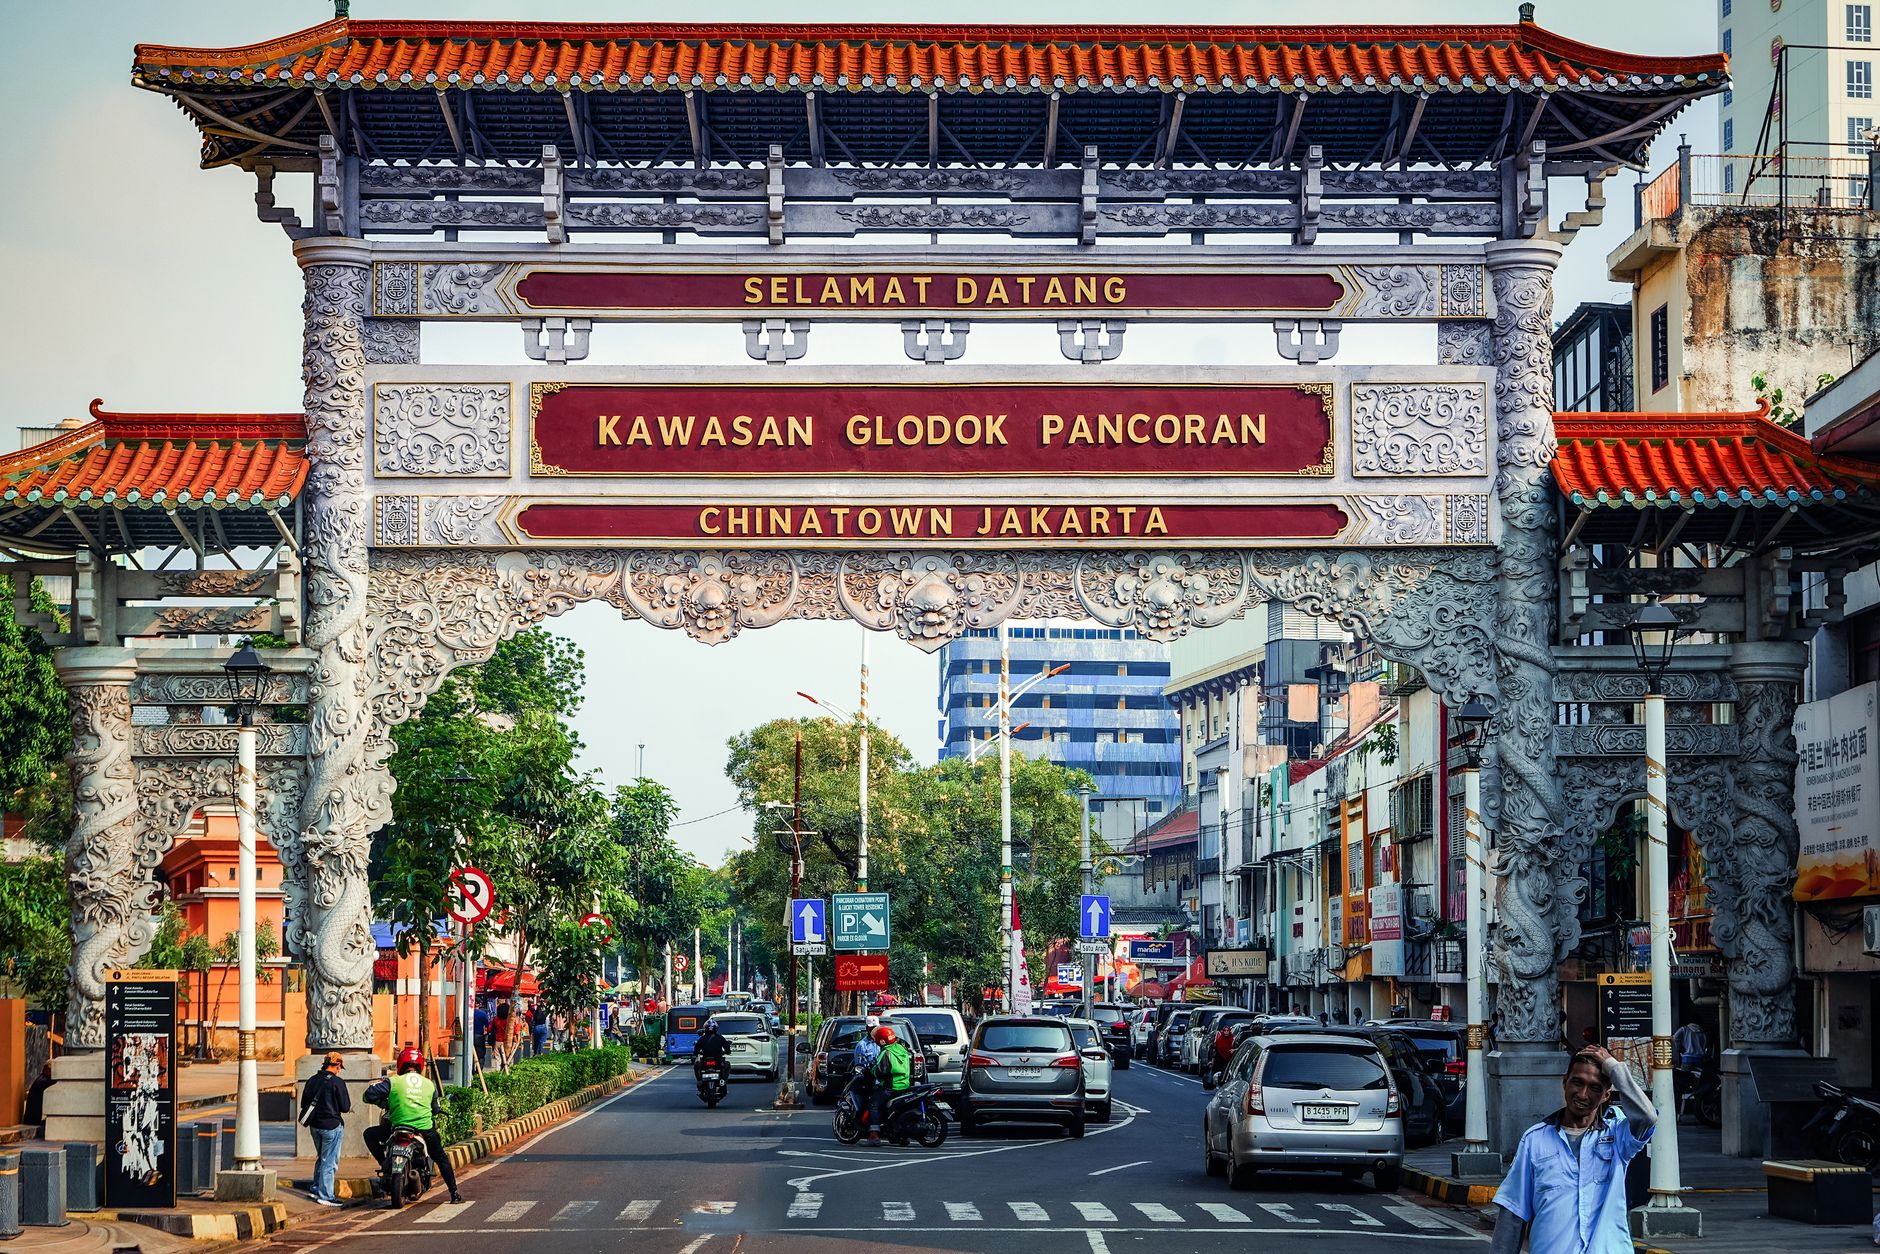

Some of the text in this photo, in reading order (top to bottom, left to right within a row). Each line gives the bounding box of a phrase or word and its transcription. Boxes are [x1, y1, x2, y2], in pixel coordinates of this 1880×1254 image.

[743, 275, 1128, 306] SELAMAT DATANG
[597, 413, 1267, 447] KAWASAN GLODOK PANCORAN
[698, 506, 1169, 536] CHINATOWN JAKARTA
[1800, 725, 1868, 774] 中国兰州牛肉拉面
[843, 914, 856, 932] P
[1082, 944, 1107, 953] Satu Arah
[1306, 1107, 1312, 1115] B
